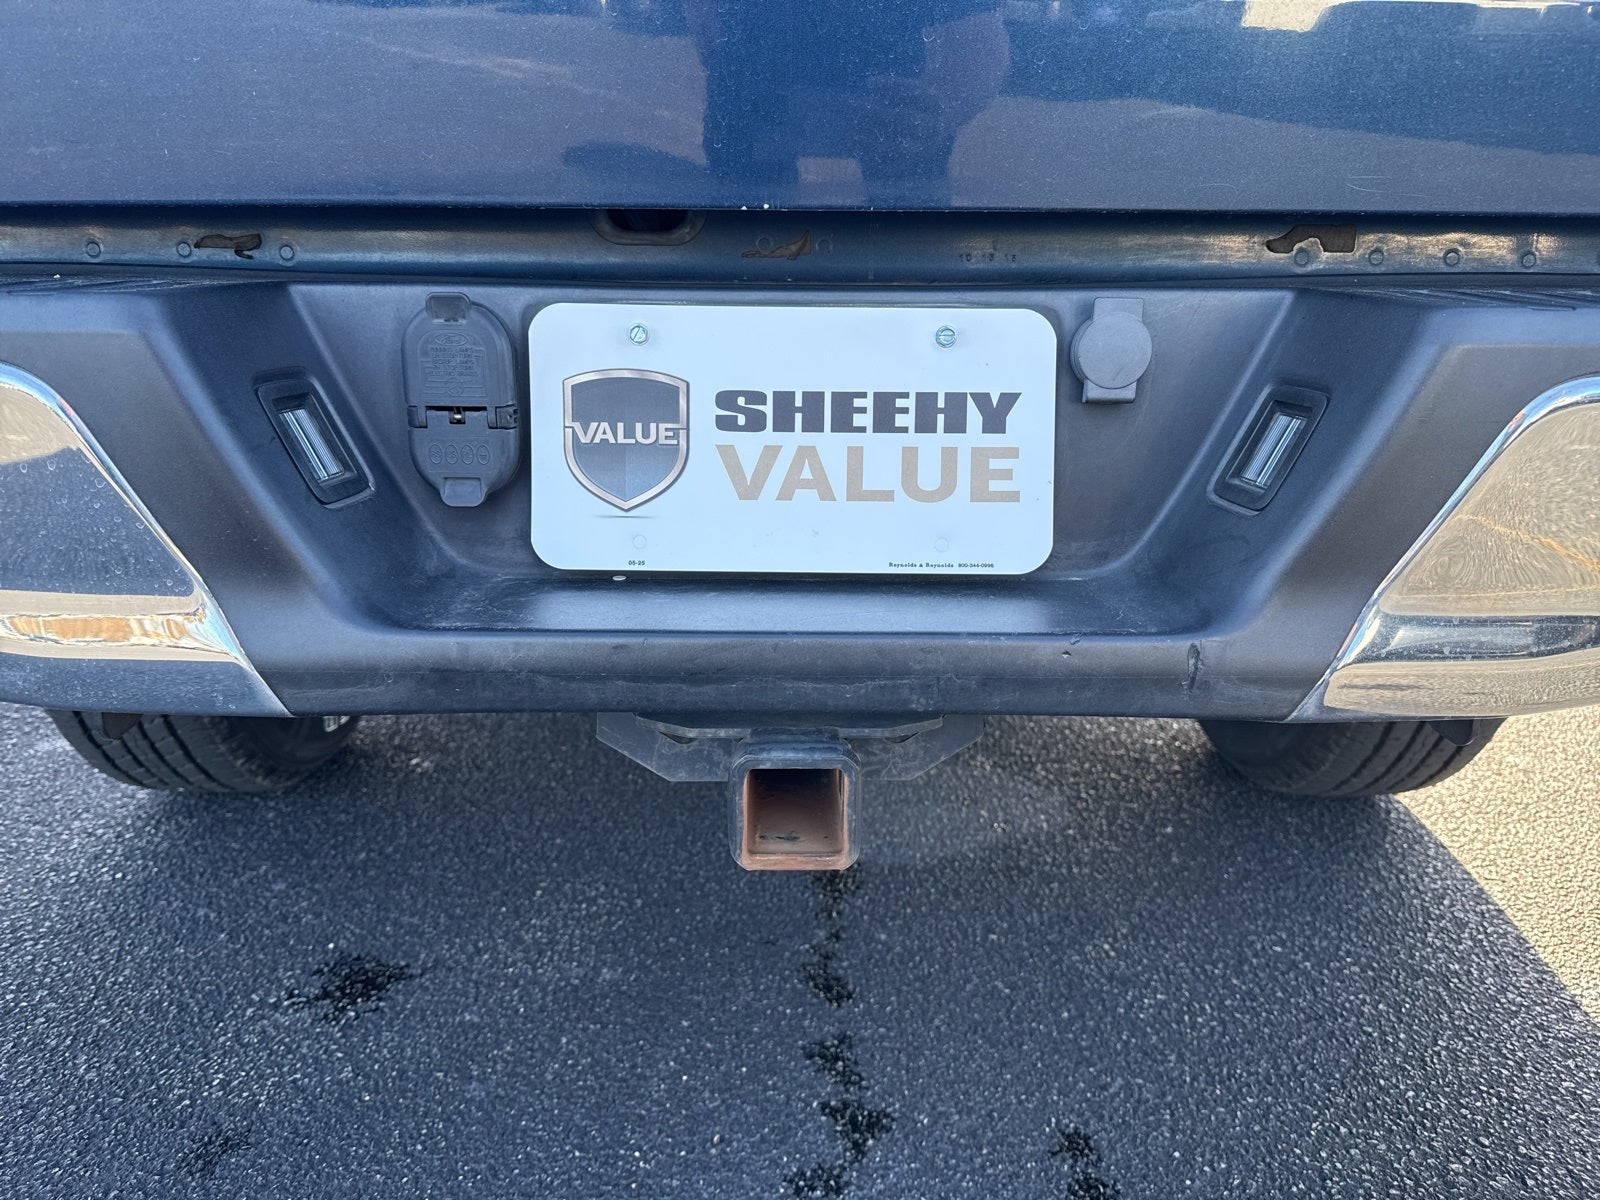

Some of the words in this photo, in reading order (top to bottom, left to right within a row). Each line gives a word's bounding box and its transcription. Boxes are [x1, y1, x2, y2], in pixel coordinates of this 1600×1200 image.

[571, 421, 679, 445] VALUE
[714, 390, 1022, 434] SHEEHY
[715, 444, 1021, 503] VALUE
